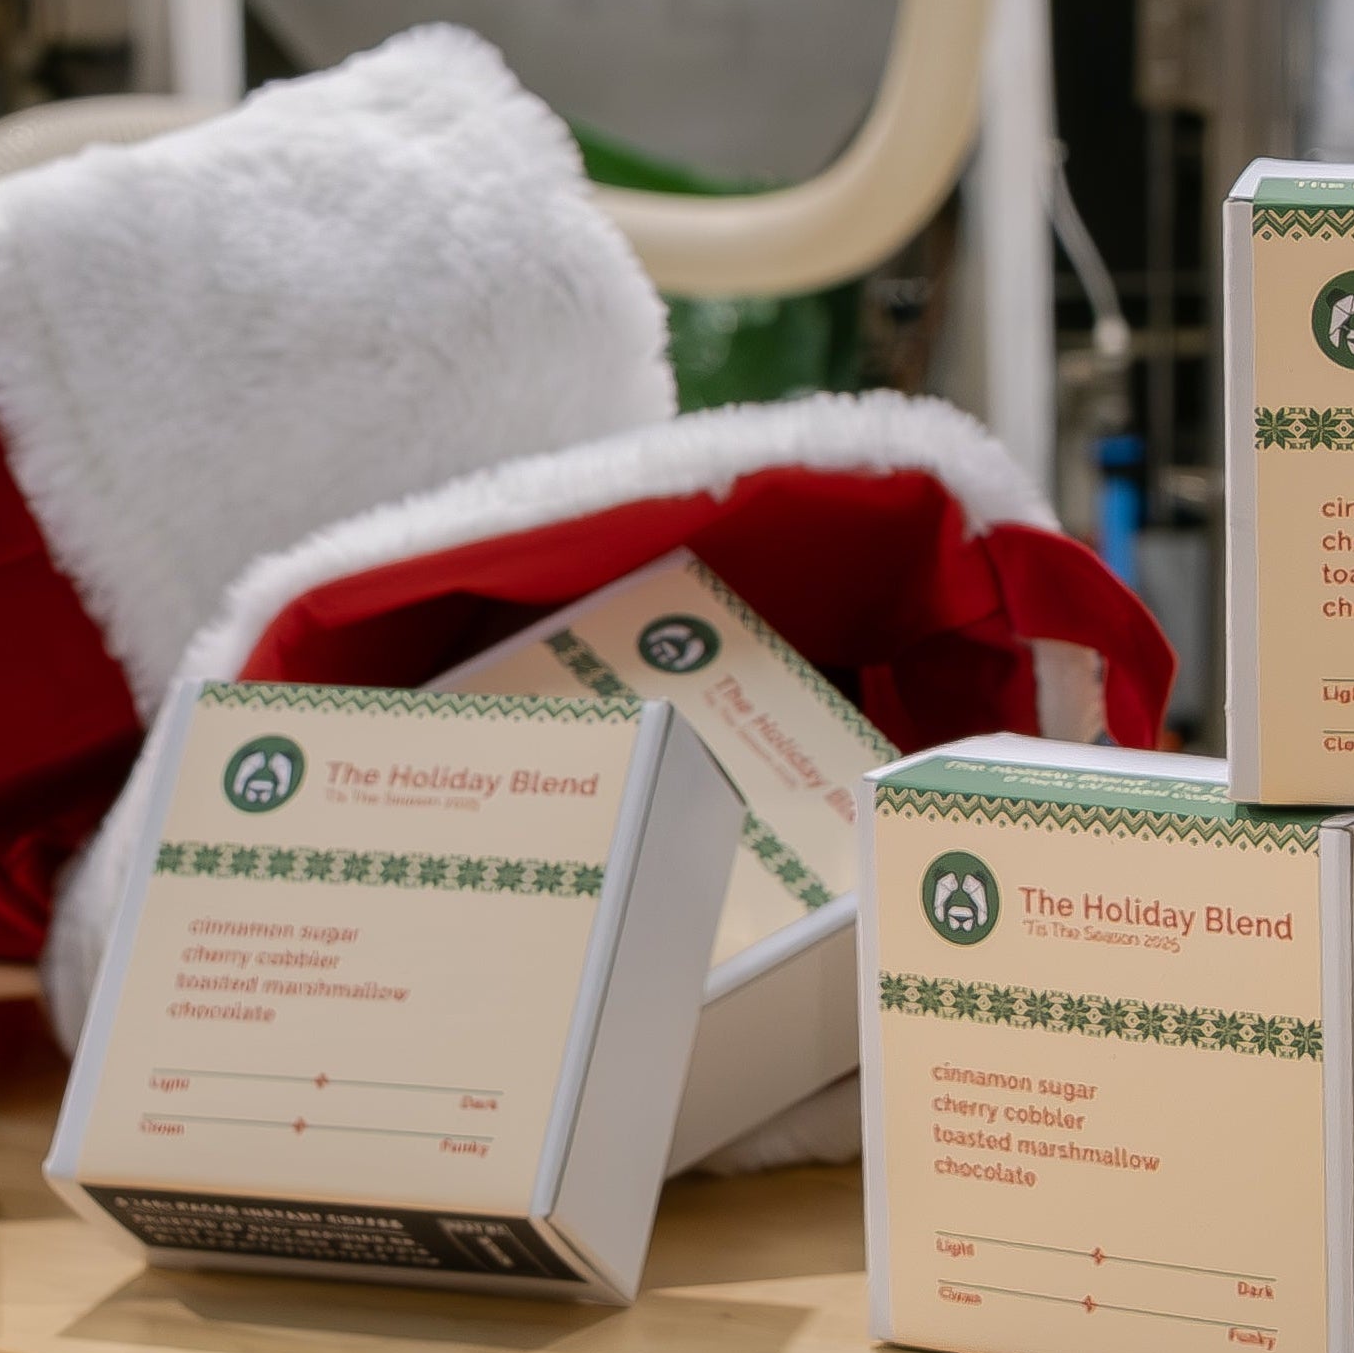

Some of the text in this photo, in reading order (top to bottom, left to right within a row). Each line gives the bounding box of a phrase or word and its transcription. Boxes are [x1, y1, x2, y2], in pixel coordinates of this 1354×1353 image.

[326, 761, 598, 800] The Holiday Blend
[1020, 887, 1292, 940] The Holiday Blend
[932, 1063, 1096, 1103] cinnamon sugar
[934, 1125, 1159, 1172] toasted marshmallow
